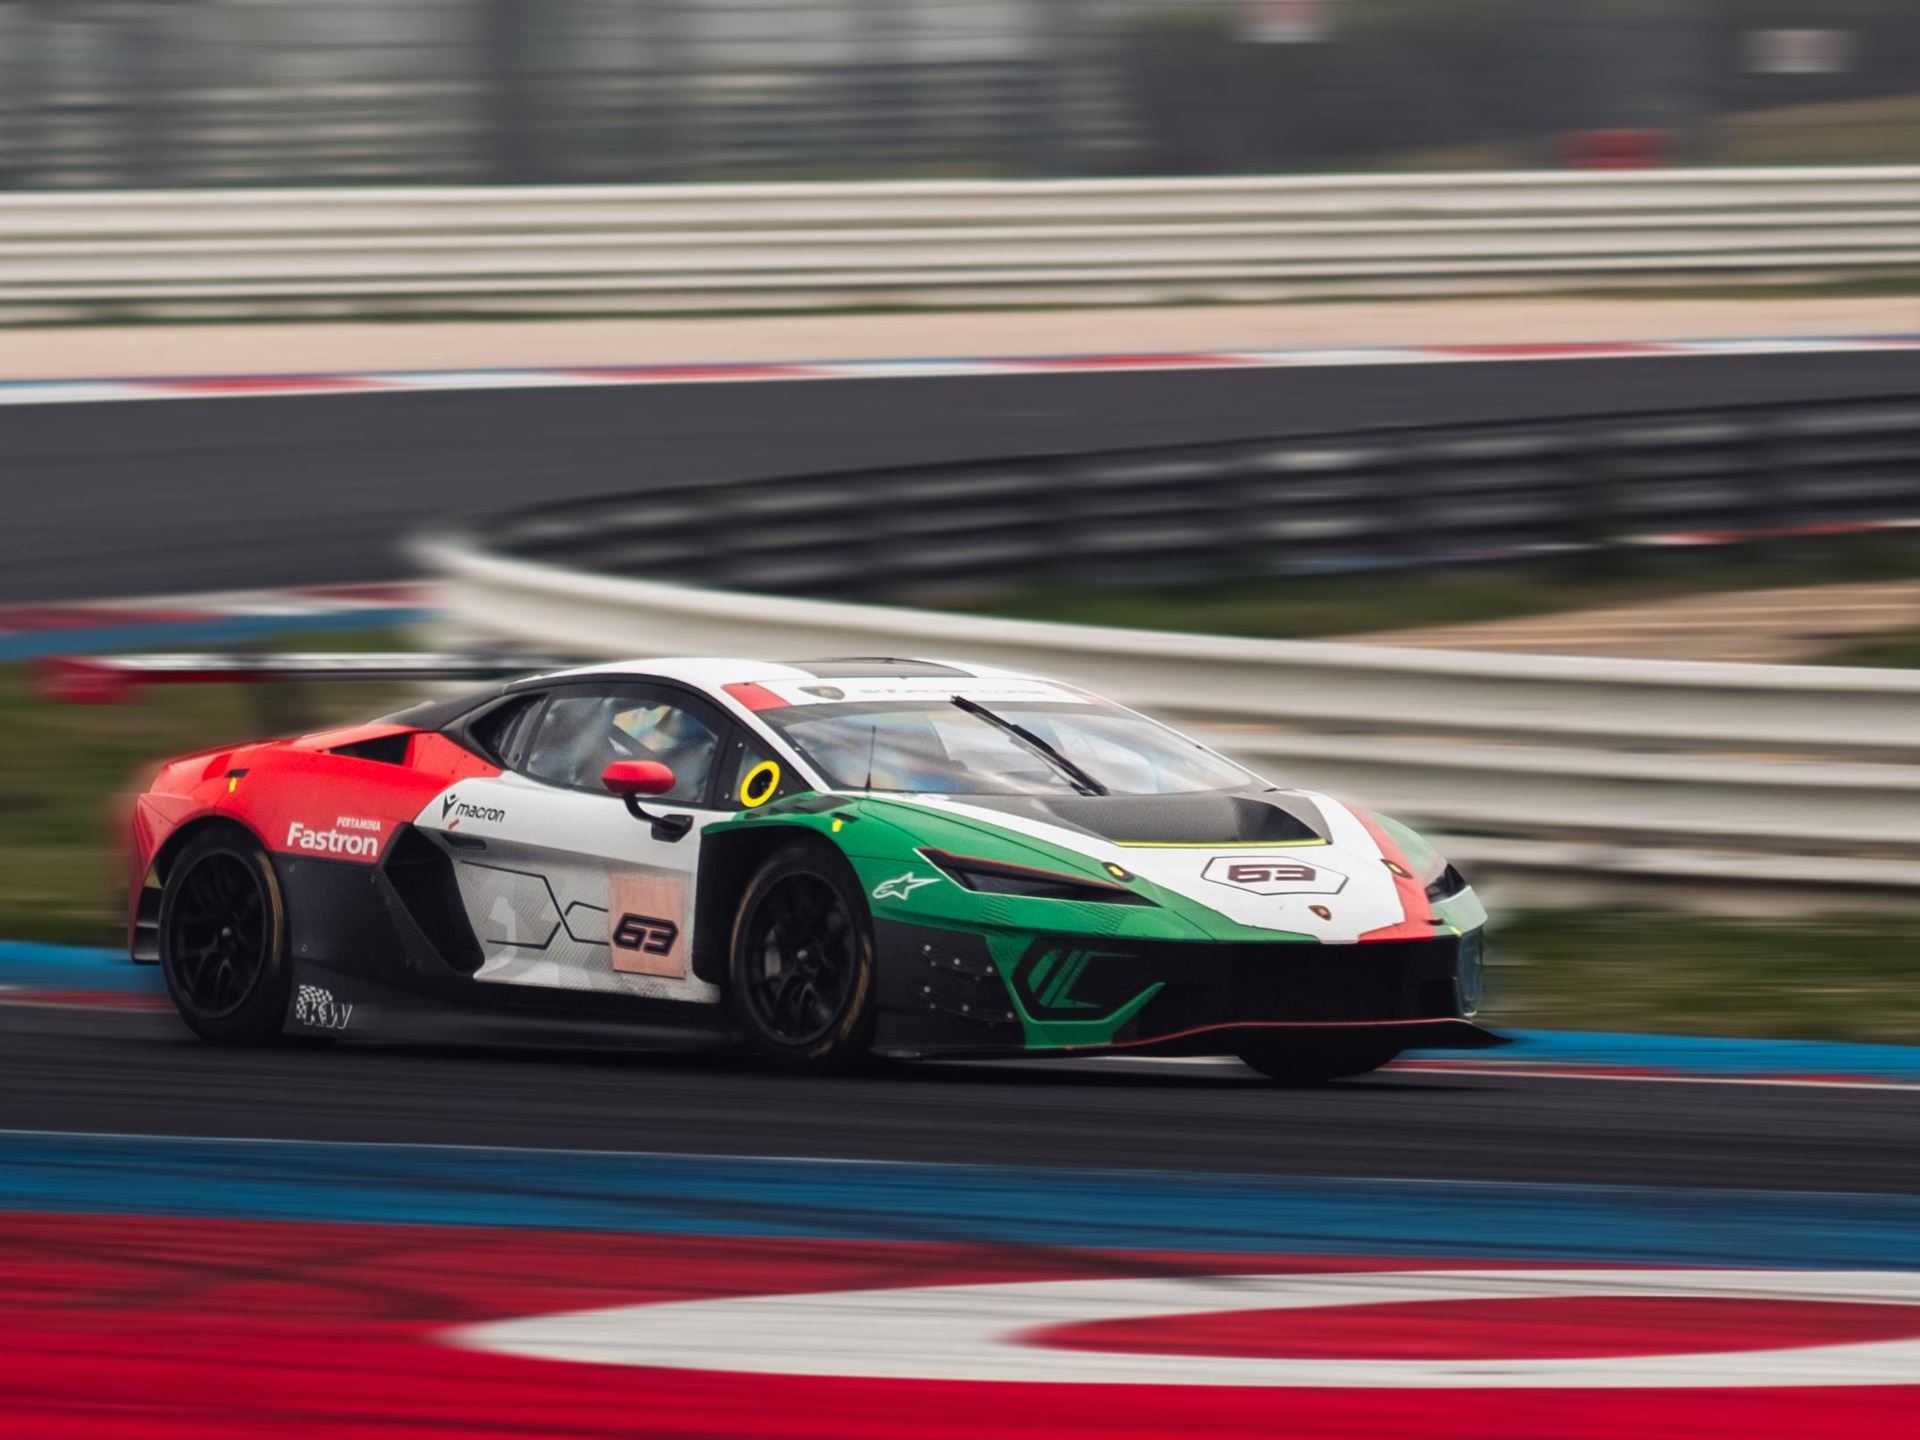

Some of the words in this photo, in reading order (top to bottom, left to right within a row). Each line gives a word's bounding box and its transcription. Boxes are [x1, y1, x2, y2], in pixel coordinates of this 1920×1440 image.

[455, 802, 505, 823] macron
[286, 821, 378, 857] Fastron
[1227, 863, 1316, 884] 63
[612, 911, 679, 957] 63
[303, 997, 353, 1030] KW
